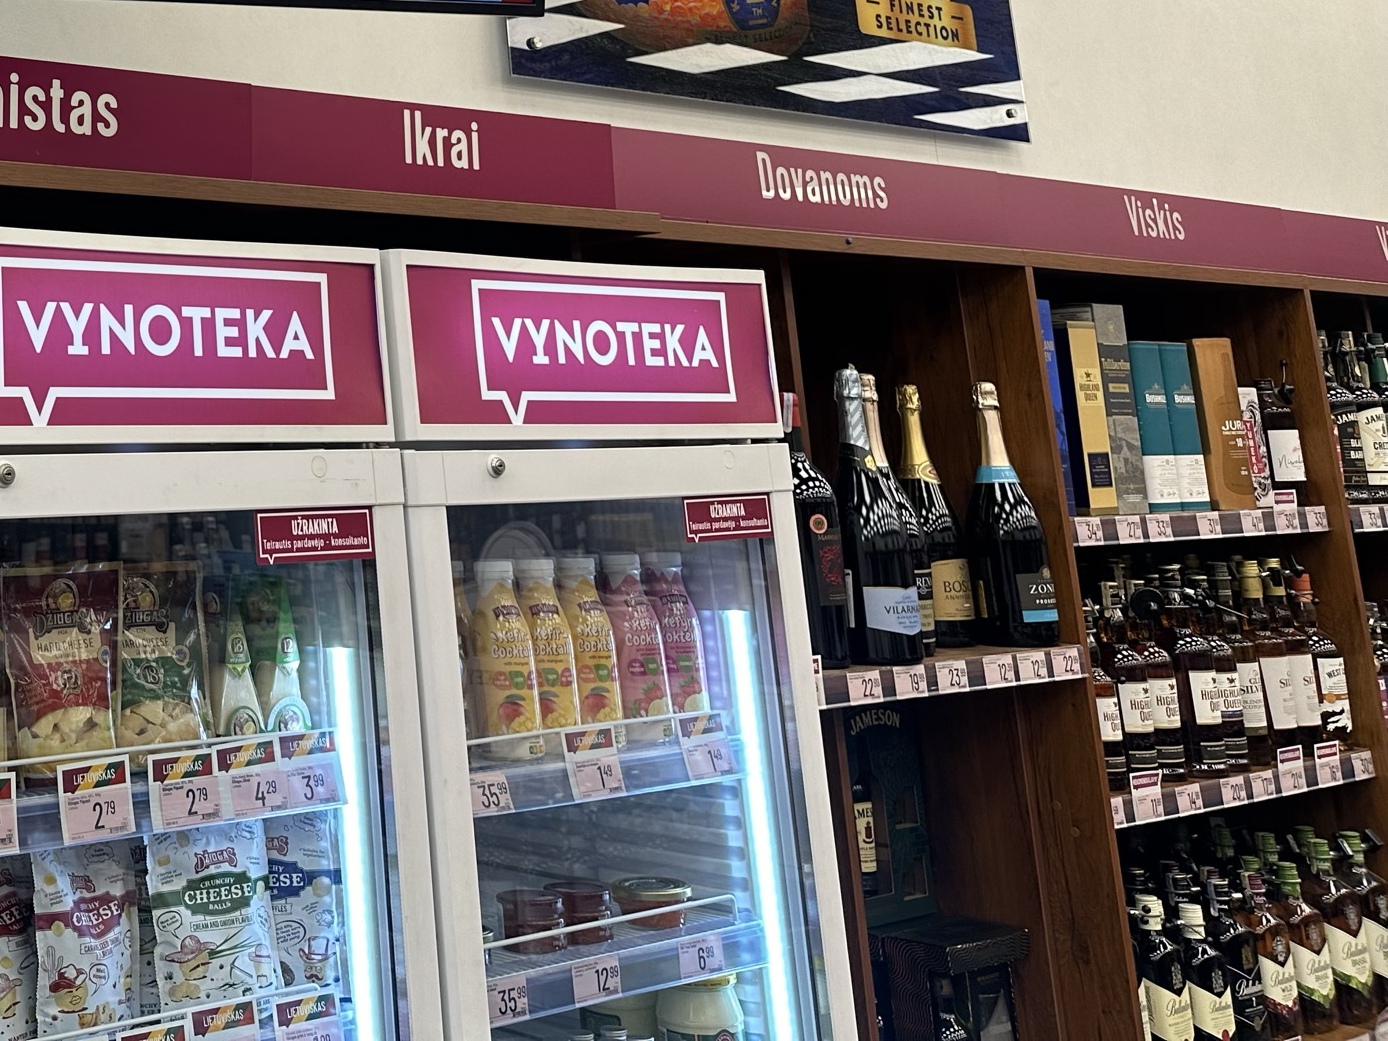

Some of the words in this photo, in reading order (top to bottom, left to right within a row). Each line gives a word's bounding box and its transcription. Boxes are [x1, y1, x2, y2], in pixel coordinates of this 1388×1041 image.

[875, 13, 961, 43] SELECTION
[403, 109, 481, 171] Ikrai
[755, 151, 889, 210] Dovanoms
[1123, 195, 1185, 241] Viskis
[16, 300, 315, 361] VYNOTEKA
[491, 316, 720, 369] VYNOTEKA
[709, 501, 746, 519] UŽRAKINTA
[291, 516, 339, 536] UŽRAKINTA
[263, 539, 292, 550] Teirautis
[36, 640, 60, 653] HARD
[61, 637, 95, 651] CHEESE
[849, 709, 901, 736] JAMESON
[226, 747, 266, 763] LIETUVIŠKAS
[72, 768, 116, 785] LIETUVIŠKAS
[162, 759, 203, 775] LIETUVIŠKAS
[185, 788, 197, 816] 2
[197, 787, 208, 803] 79
[255, 781, 266, 807] 4
[266, 779, 277, 795] 29
[481, 784, 501, 810] 35
[184, 882, 253, 905] CHEESE
[200, 877, 235, 888] CRUNCHY
[208, 902, 231, 910] BALLS
[203, 1006, 245, 1027] LIETUVIŠKAS
[286, 1001, 326, 1019] LIETUVIŠKAS
